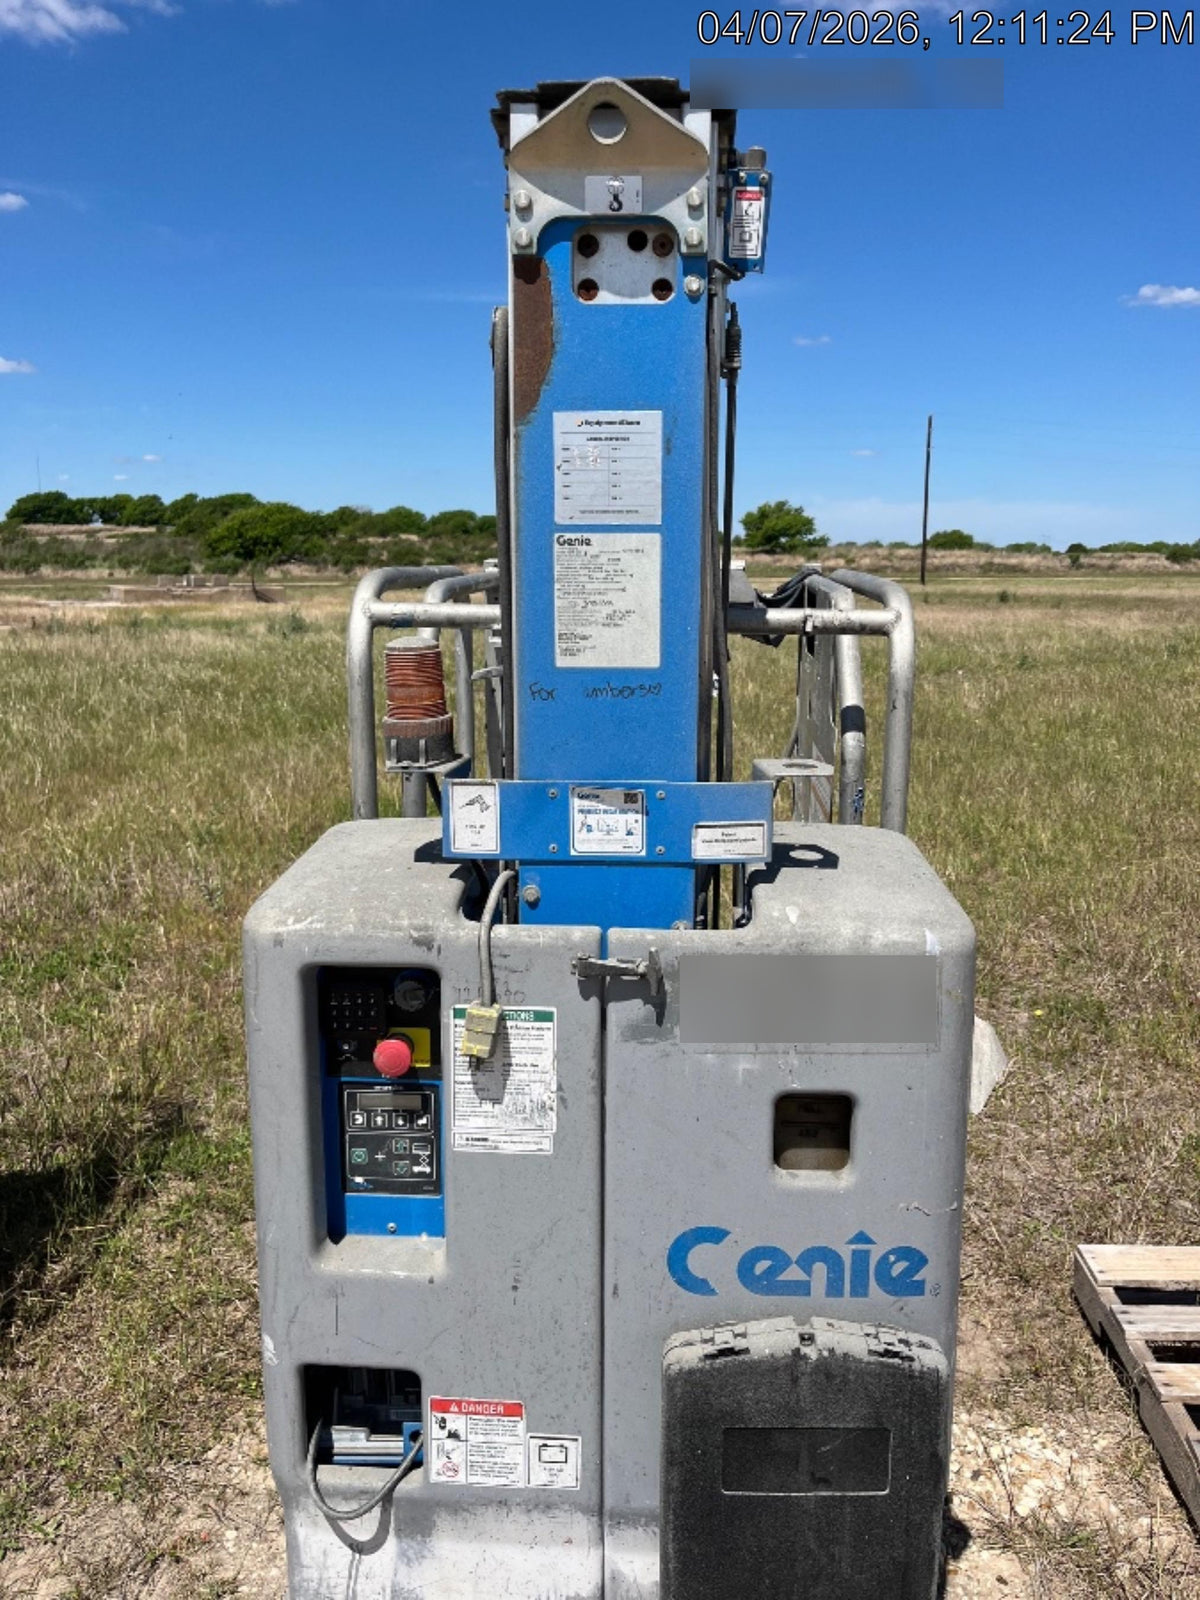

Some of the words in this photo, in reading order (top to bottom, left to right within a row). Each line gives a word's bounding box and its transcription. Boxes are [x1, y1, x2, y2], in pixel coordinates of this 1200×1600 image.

[556, 534, 593, 547] Genie
[666, 1225, 929, 1298] Genie
[461, 1402, 504, 1415] DANGER
